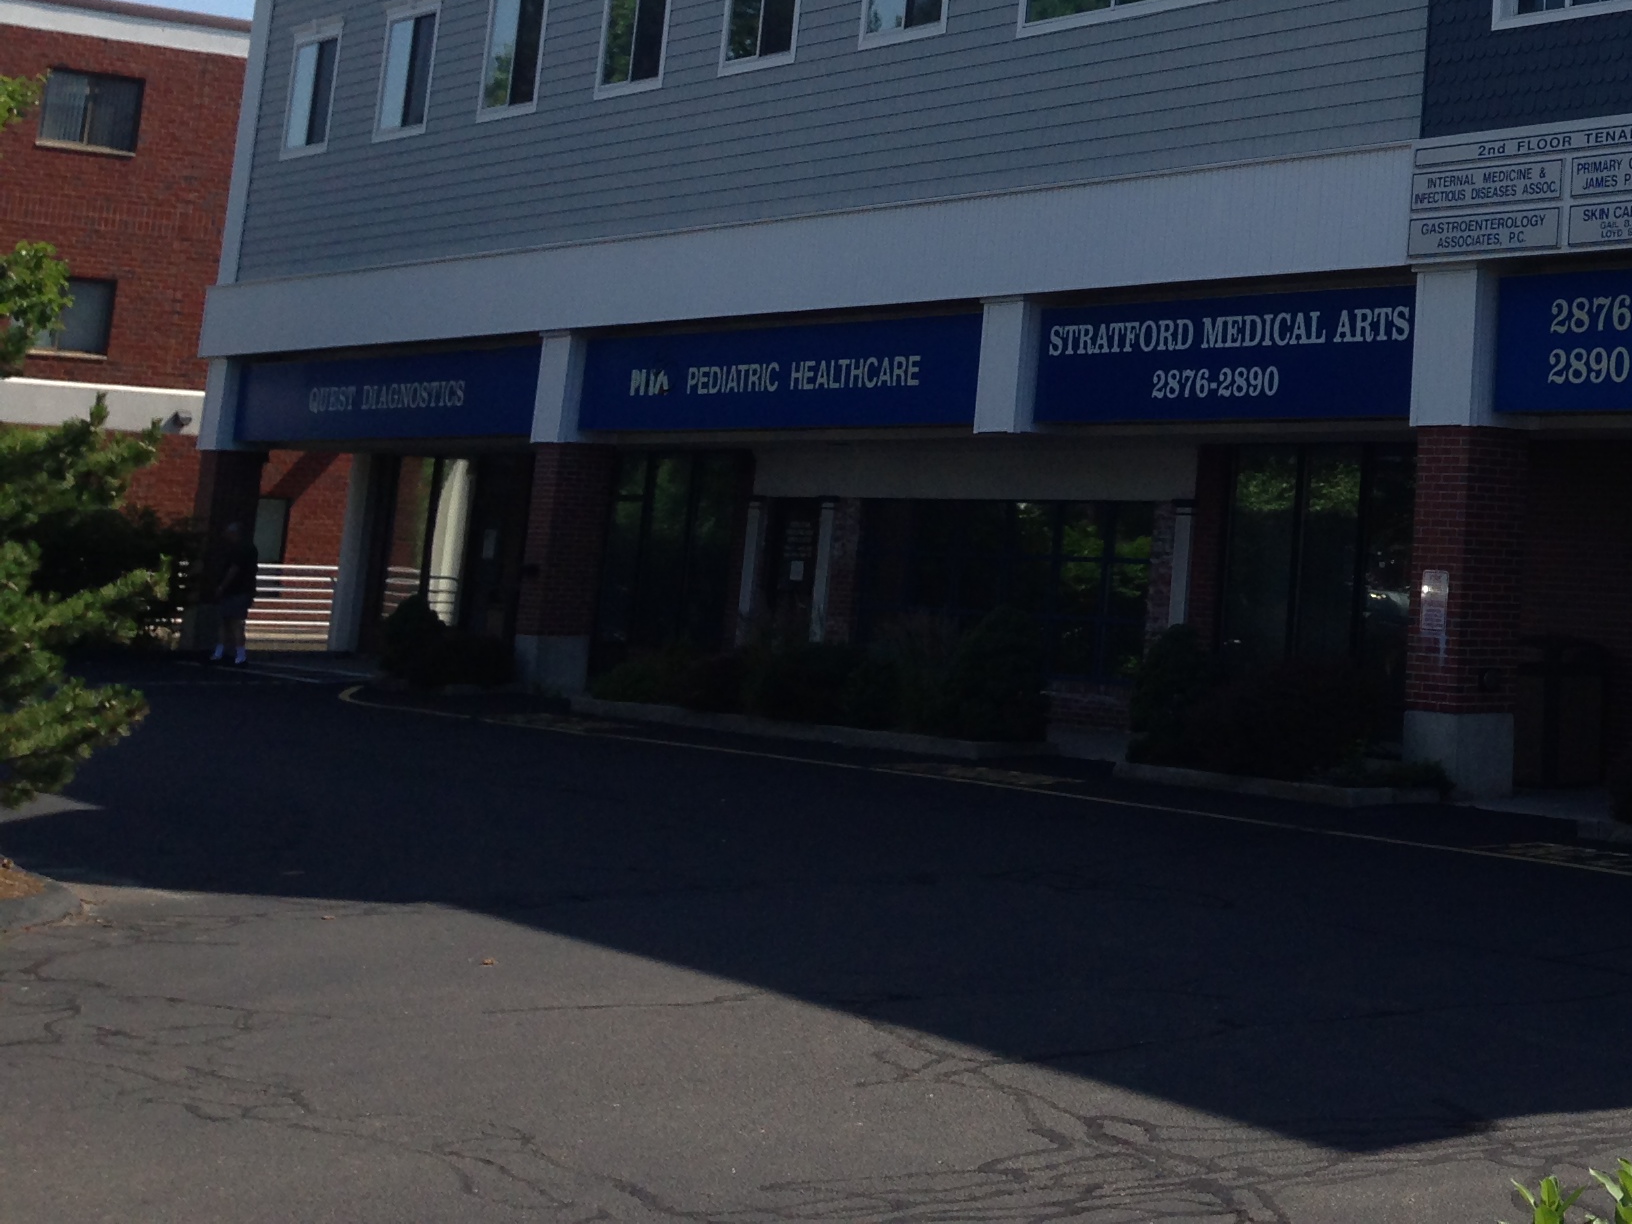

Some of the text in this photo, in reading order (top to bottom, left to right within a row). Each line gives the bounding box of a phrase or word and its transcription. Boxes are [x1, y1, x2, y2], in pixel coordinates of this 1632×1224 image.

[1477, 142, 1506, 157] 2nd
[1517, 134, 1572, 153] FLOOR
[1427, 166, 1547, 189] INTERNAL MEDICINE &
[1576, 158, 1623, 175] PRIMARY
[1413, 180, 1559, 205] INFECTIOUS DISEASES ASSOC.
[1582, 175, 1619, 191] JAMES
[1420, 213, 1547, 236] GASTROENTEROLOGY
[1582, 206, 1610, 222] SKIN
[1437, 232, 1502, 249] ASSOCIATES,
[1549, 294, 1632, 334] 2876
[1048, 306, 1410, 357] STRATFORD MEDICAL ARTS
[686, 361, 780, 395] PEDIATRIC
[789, 354, 922, 391] HEALTHCARE
[1547, 346, 1631, 385] 2890
[1150, 365, 1280, 399] 2876-2890
[308, 380, 466, 414] QUEST DIAGNOSTICS
